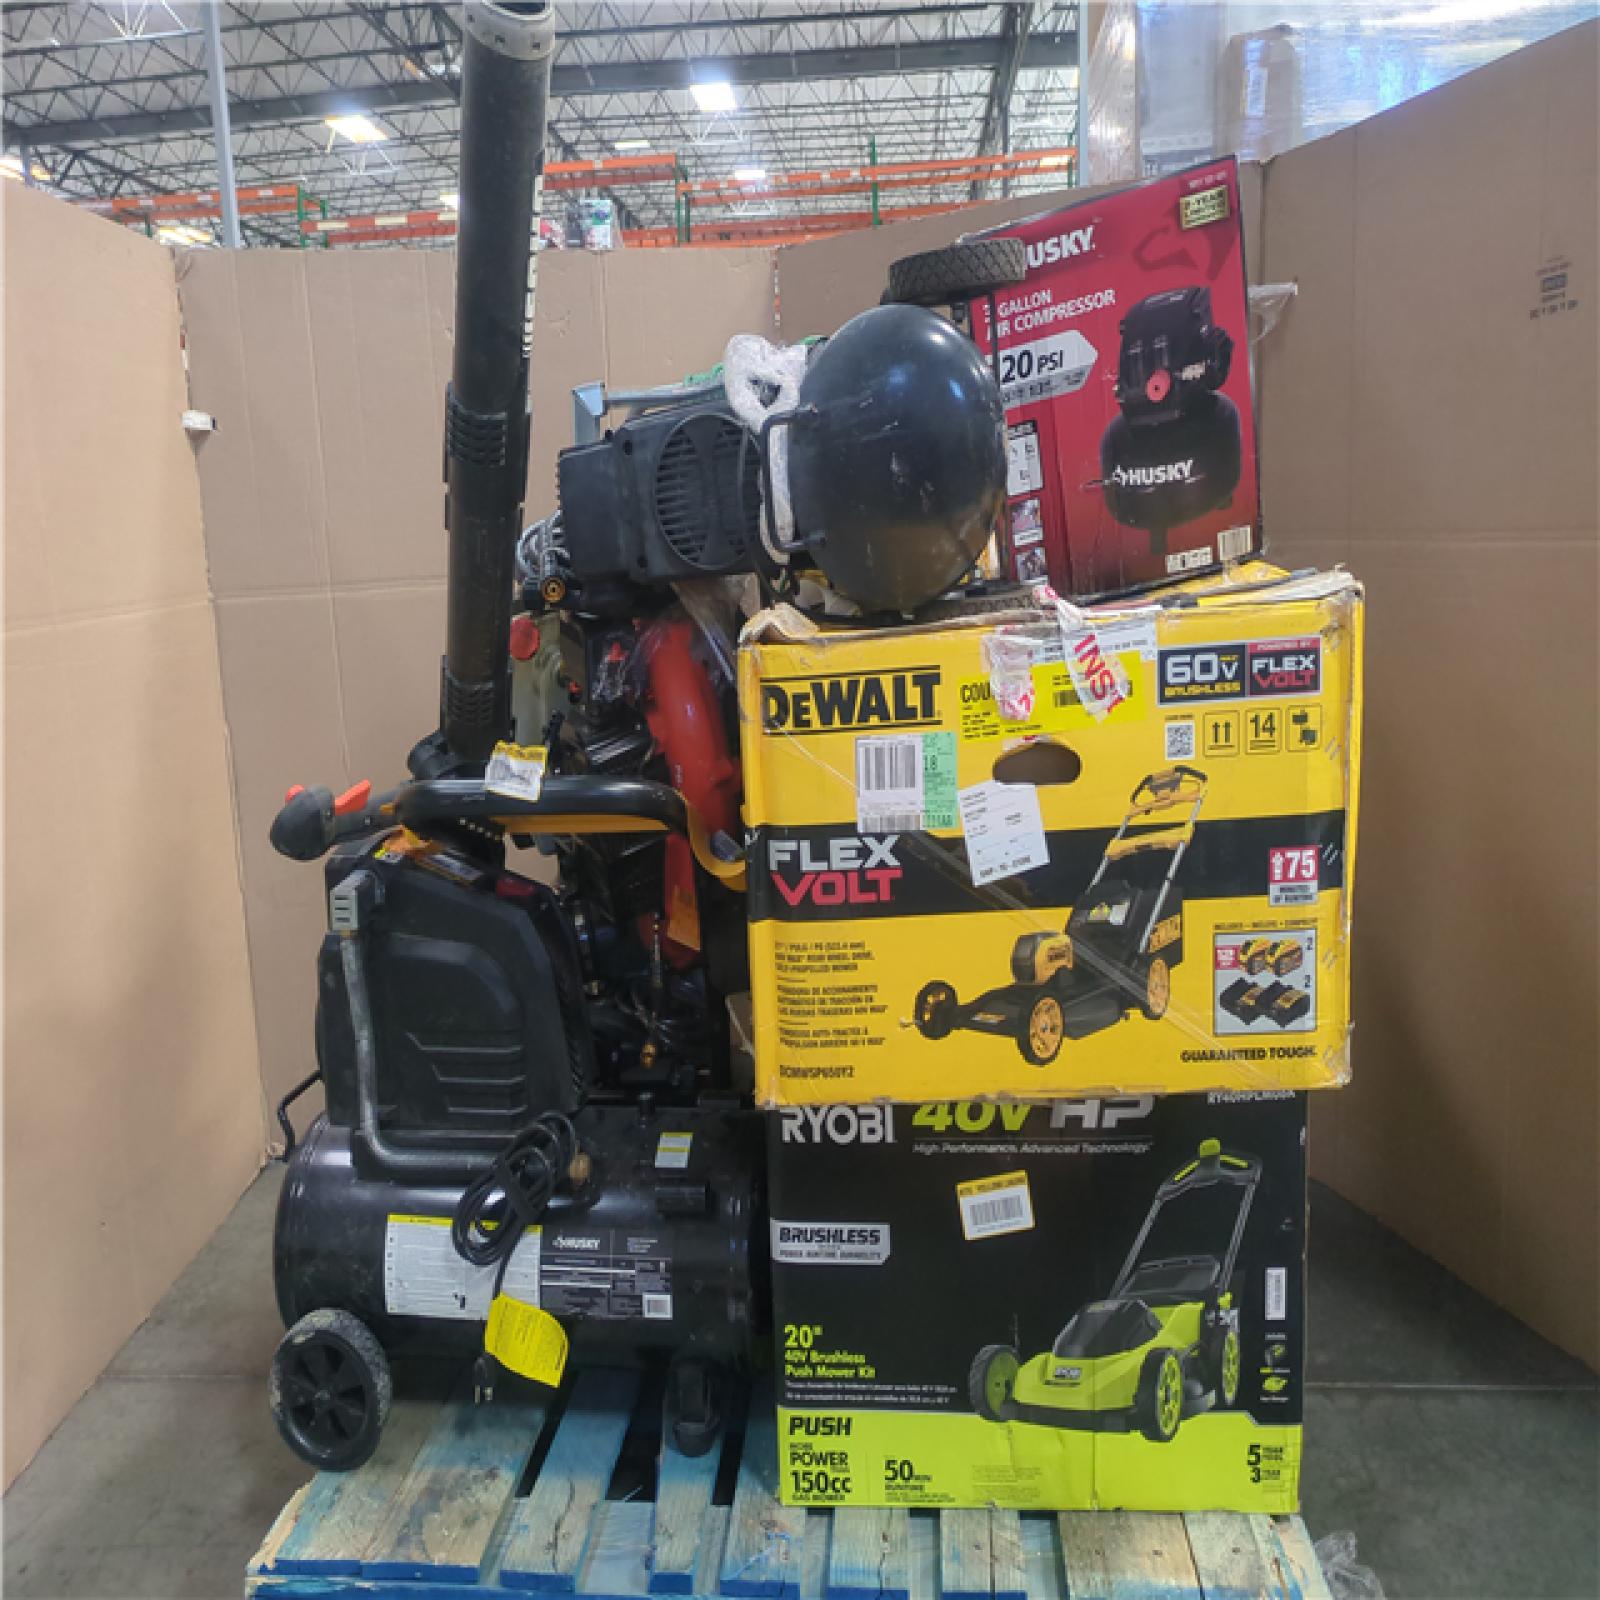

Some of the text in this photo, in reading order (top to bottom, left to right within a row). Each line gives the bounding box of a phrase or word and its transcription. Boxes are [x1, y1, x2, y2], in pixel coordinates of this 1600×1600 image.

[998, 290, 1052, 317] GALLON
[1014, 289, 1115, 332] COMPRESSOR
[1037, 350, 1063, 375] PSI
[1129, 459, 1193, 486] HUSKY
[1252, 654, 1316, 674] FLEX
[1254, 669, 1316, 689] VOLT
[1250, 712, 1276, 739] 14
[769, 834, 901, 871] FLEX
[1284, 849, 1317, 880] 75
[772, 868, 904, 906] VOLT
[1181, 1047, 1267, 1063] GUARANTEED
[780, 1104, 895, 1145] RYOBI
[779, 1227, 881, 1246] BRUSHLESS
[810, 1351, 866, 1364] Brushless
[785, 1365, 813, 1378] Push
[817, 1366, 855, 1379] Mower
[789, 1416, 853, 1436] PUSH
[789, 1452, 849, 1467] POWER
[1247, 1444, 1261, 1466] 5
[791, 1469, 853, 1494] 150cc
[884, 1459, 914, 1482] 50
[1249, 1467, 1261, 1484] 3
